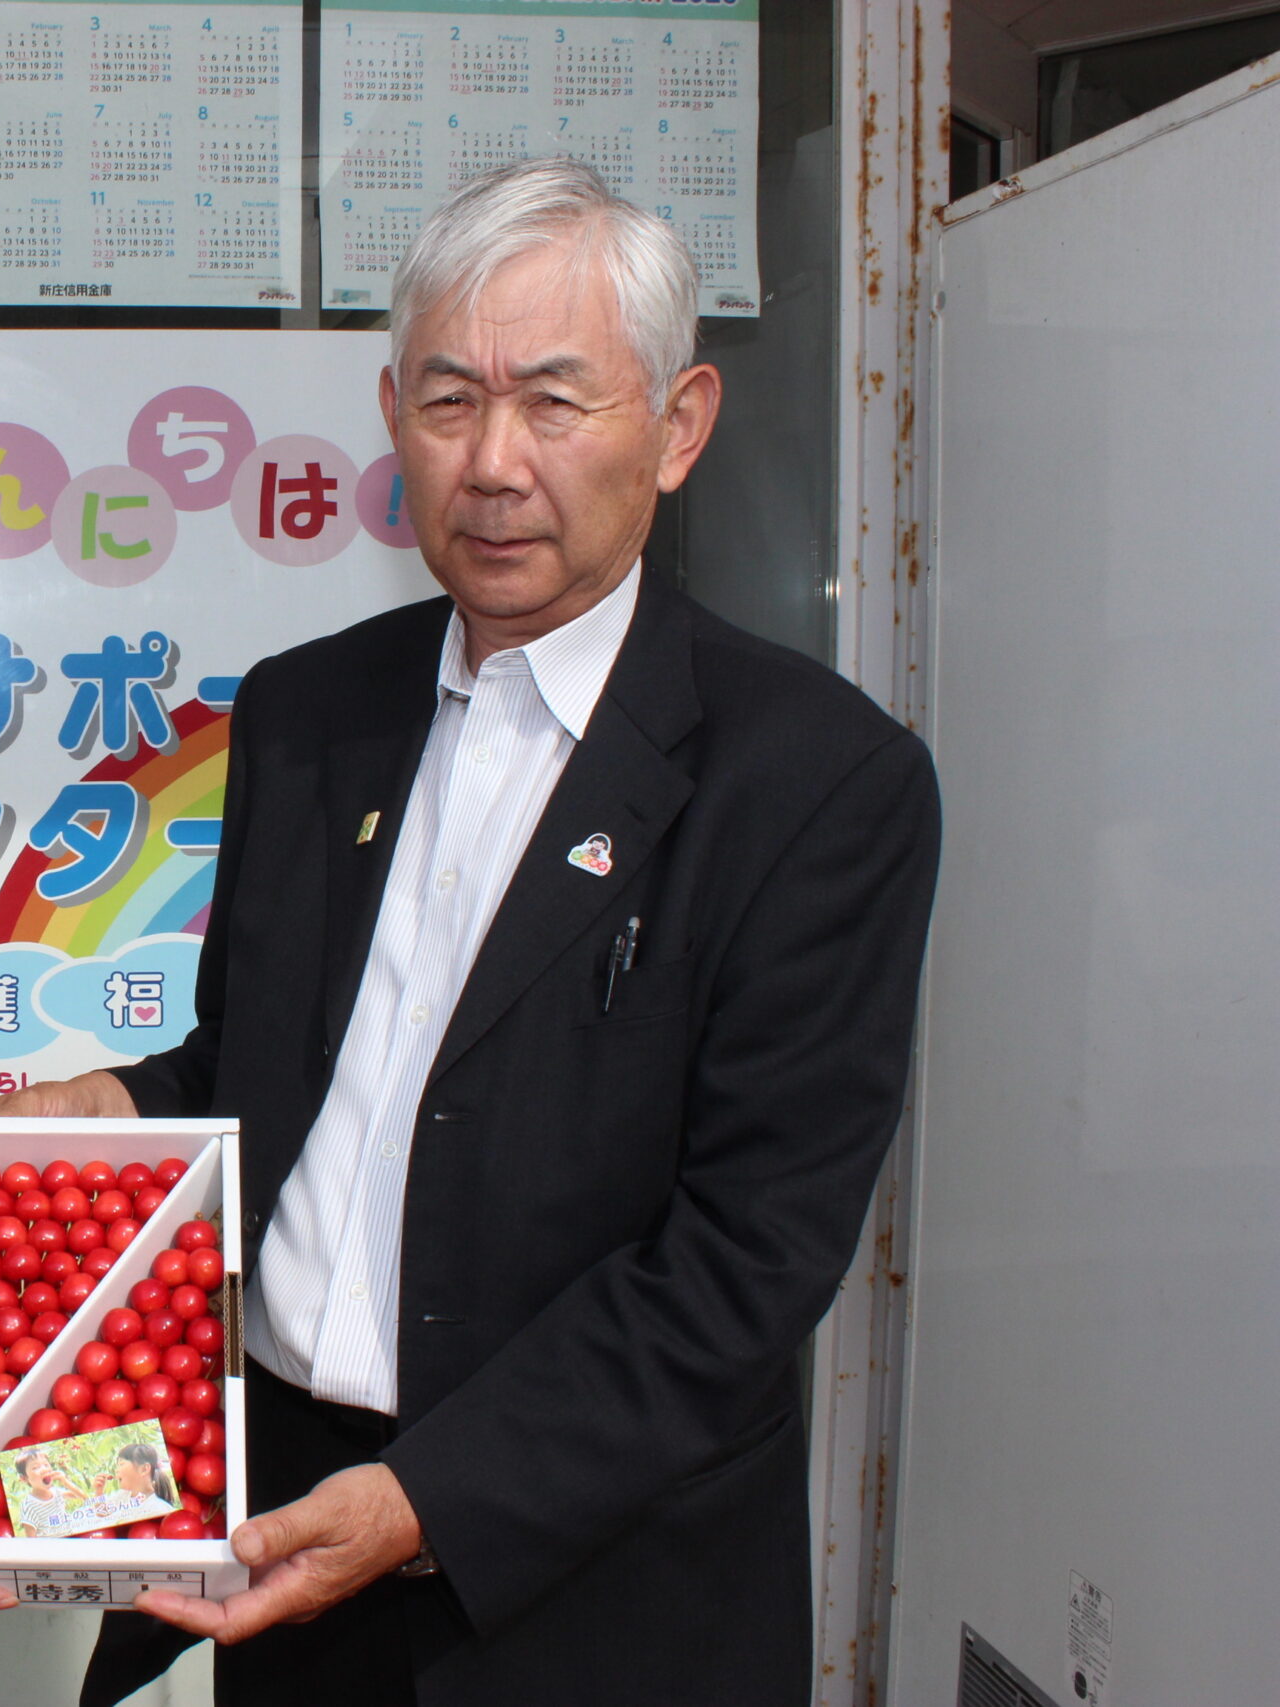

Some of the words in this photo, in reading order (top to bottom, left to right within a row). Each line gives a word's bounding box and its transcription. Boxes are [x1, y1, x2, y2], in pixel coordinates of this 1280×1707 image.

[31, 23, 64, 33] February
[90, 16, 100, 30] 3
[202, 18, 212, 31] 4
[262, 26, 280, 34] April
[346, 22, 352, 36] 1
[451, 26, 460, 40] 2
[555, 28, 565, 43] 3
[663, 32, 672, 45] 4
[95, 104, 105, 118] 7
[158, 112, 173, 120] July
[198, 106, 208, 120] 8
[255, 114, 279, 122] August
[344, 112, 353, 126] 5
[448, 114, 458, 128] 6
[559, 117, 568, 131] 7
[658, 120, 669, 133] 8
[91, 192, 105, 205] 11
[195, 193, 212, 207] 12
[342, 199, 352, 212] 9
[655, 205, 672, 219] 12
[39, 283, 113, 297] 新庄信用金庫
[103, 970, 165, 1030] 福
[25, 1583, 104, 1601] 特秀
